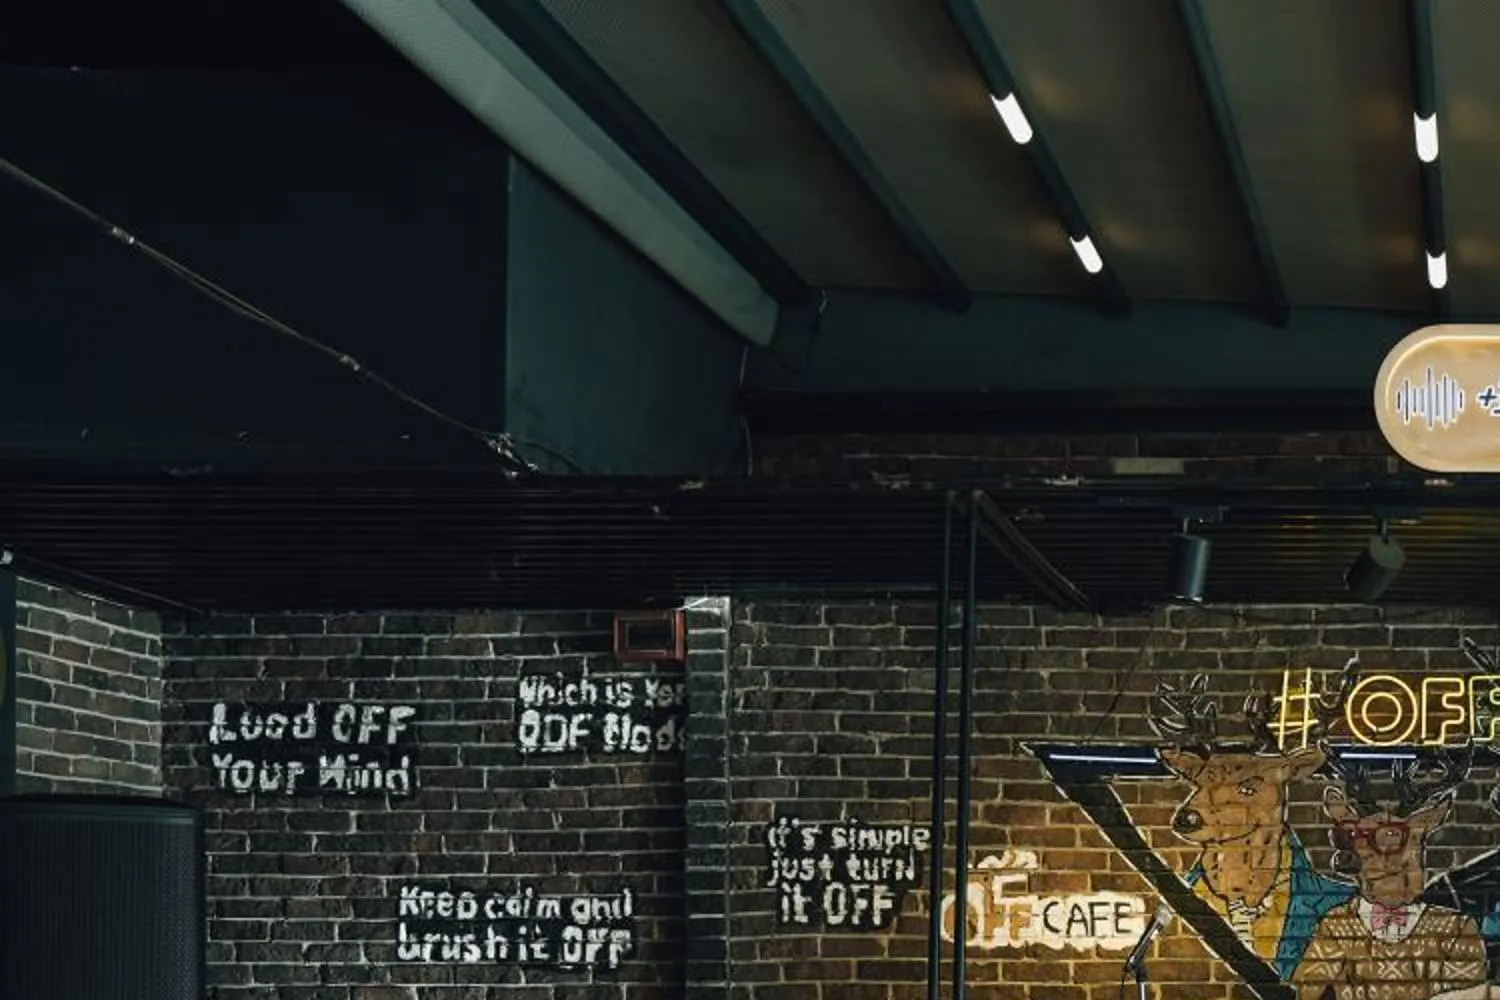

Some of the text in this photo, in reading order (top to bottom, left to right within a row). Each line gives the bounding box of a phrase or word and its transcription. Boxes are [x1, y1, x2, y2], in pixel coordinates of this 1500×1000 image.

[519, 671, 598, 708] Which
[604, 677, 635, 708] is
[332, 703, 416, 744] OFF
[830, 817, 932, 854] simple
[767, 848, 916, 886] just turn
[399, 886, 479, 920] Keep
[484, 886, 562, 919] calm
[780, 881, 896, 926] it OFF
[1042, 900, 1132, 938] CAFE
[397, 921, 633, 969] brush it OFF
